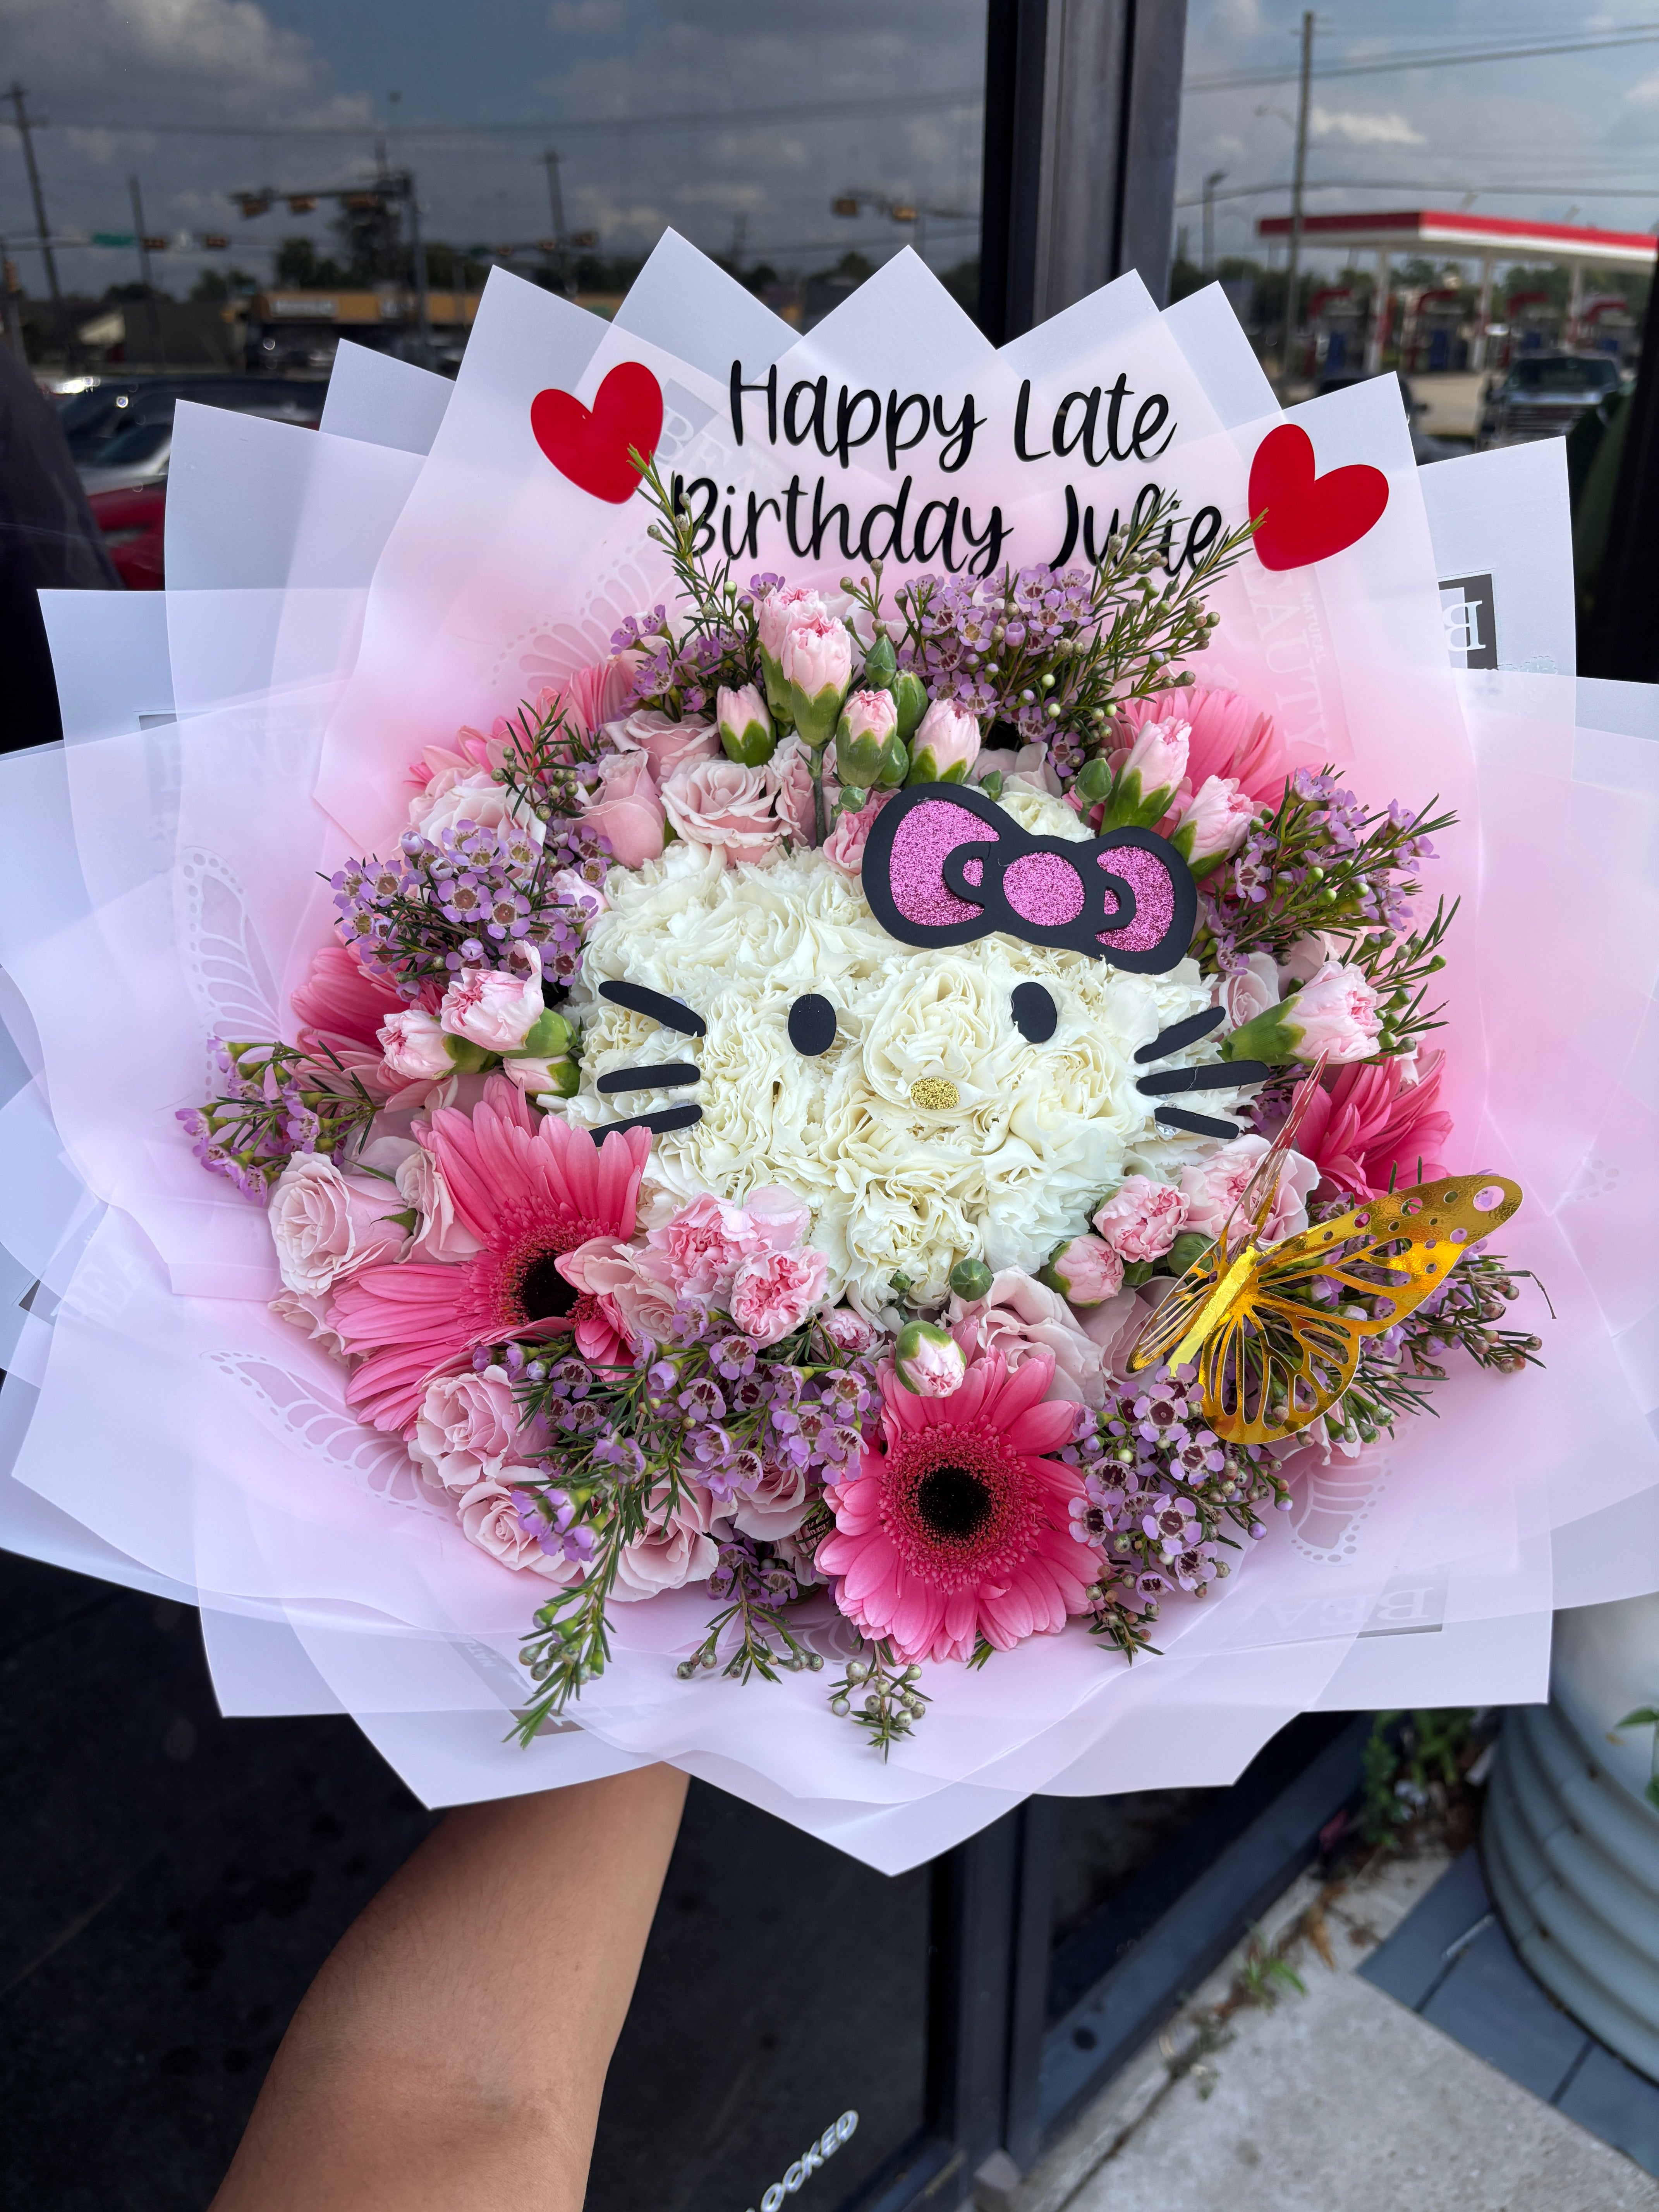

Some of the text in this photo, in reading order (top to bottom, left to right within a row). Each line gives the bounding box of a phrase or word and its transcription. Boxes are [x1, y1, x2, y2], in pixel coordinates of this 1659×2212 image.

[730, 359, 1178, 473] Happy Late
[674, 474, 1230, 580] Birthday Julie
[1240, 562, 1331, 753] EAUTY
[745, 2109, 859, 2212] OCKED
